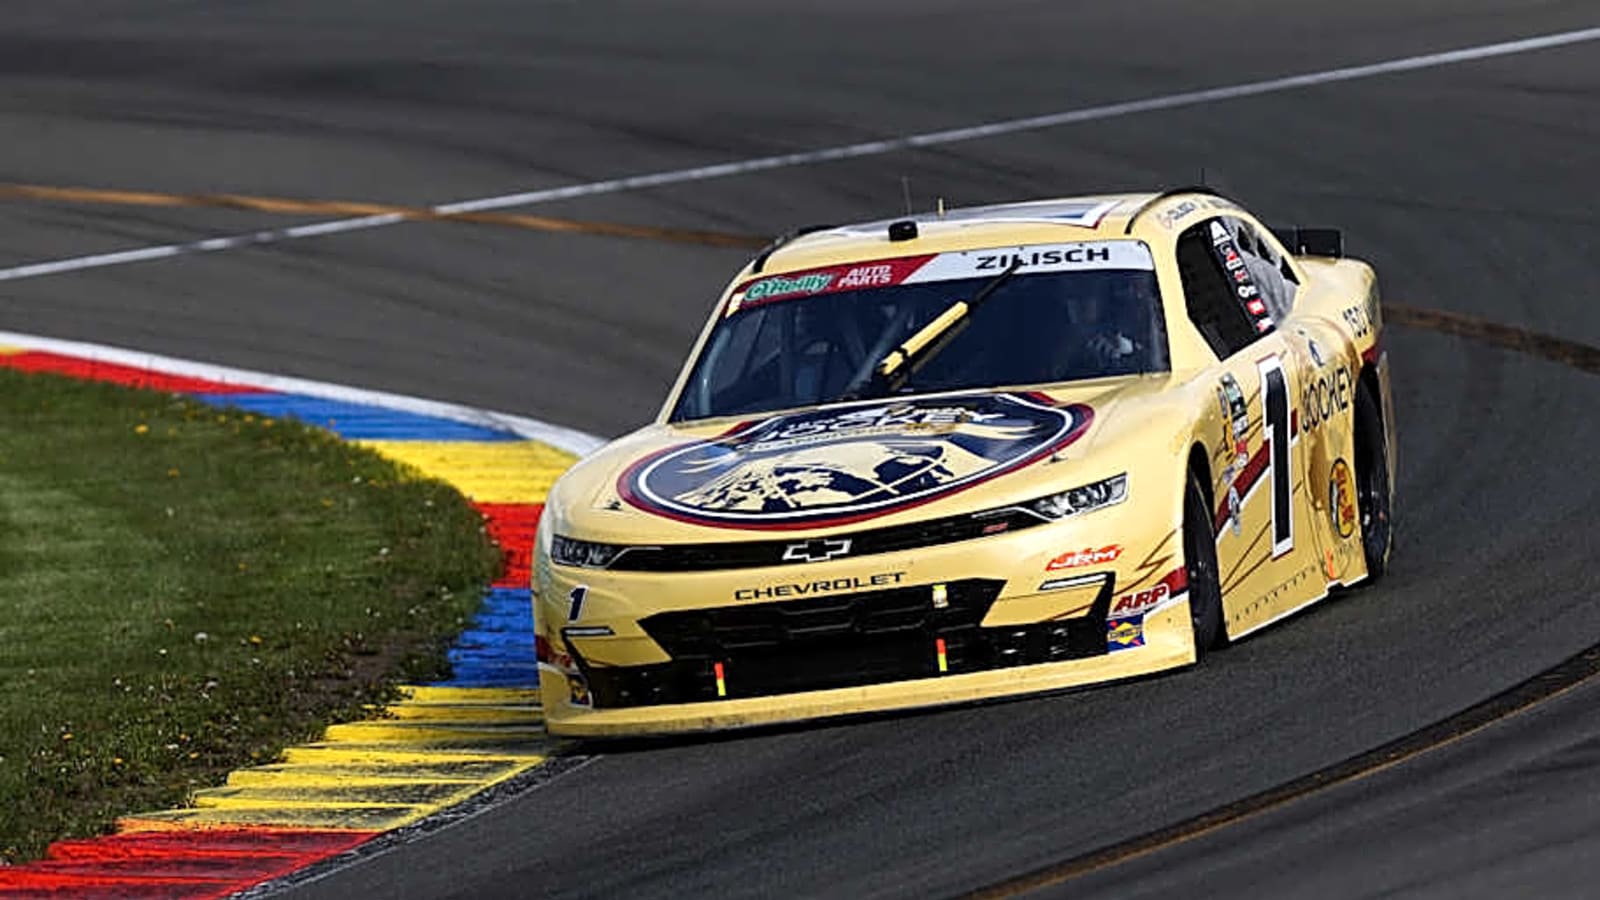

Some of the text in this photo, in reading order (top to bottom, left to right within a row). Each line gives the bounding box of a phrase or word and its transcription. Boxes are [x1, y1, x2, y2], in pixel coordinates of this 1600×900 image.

[848, 264, 892, 277] AUTO
[975, 247, 1110, 270] ZILISCH
[838, 273, 893, 288] PARTS
[1260, 360, 1292, 554] 1
[1049, 548, 1118, 570] JRM
[734, 571, 907, 601] CHEVROLET
[1113, 585, 1168, 612] ARP
[568, 586, 588, 622] 1
